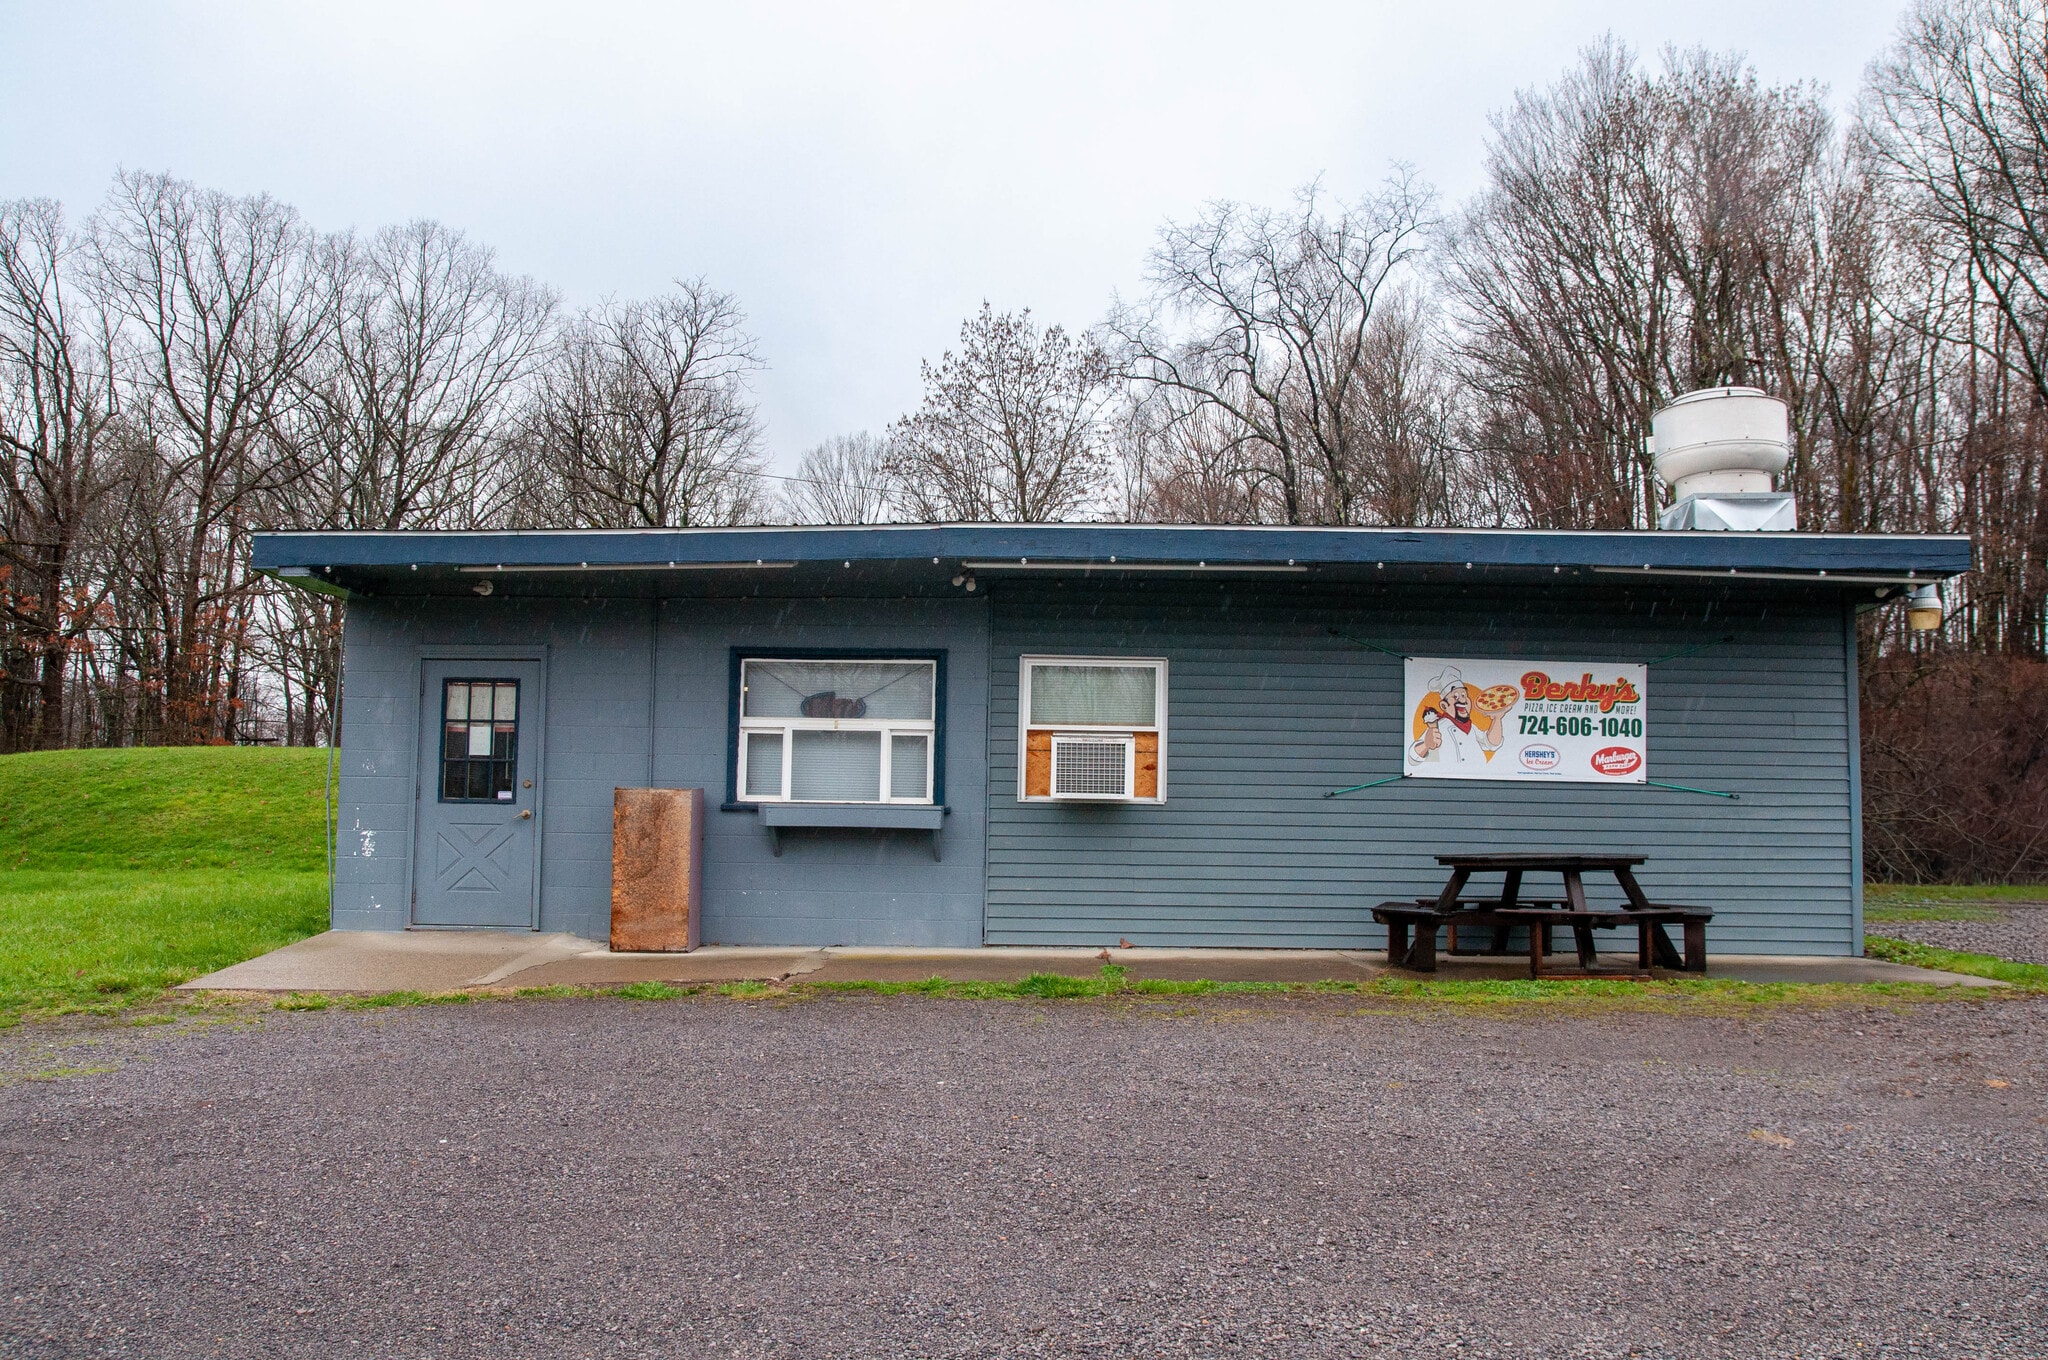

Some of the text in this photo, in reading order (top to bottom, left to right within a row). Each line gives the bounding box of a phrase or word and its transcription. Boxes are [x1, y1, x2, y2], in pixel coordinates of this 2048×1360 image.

[1520, 671, 1640, 714] Berky's
[1546, 703, 1557, 713] ICE
[1560, 704, 1582, 714] CREAM
[1584, 705, 1598, 714] AND
[1615, 705, 1637, 715] MORE!
[1518, 715, 1643, 738] 724-606-1040
